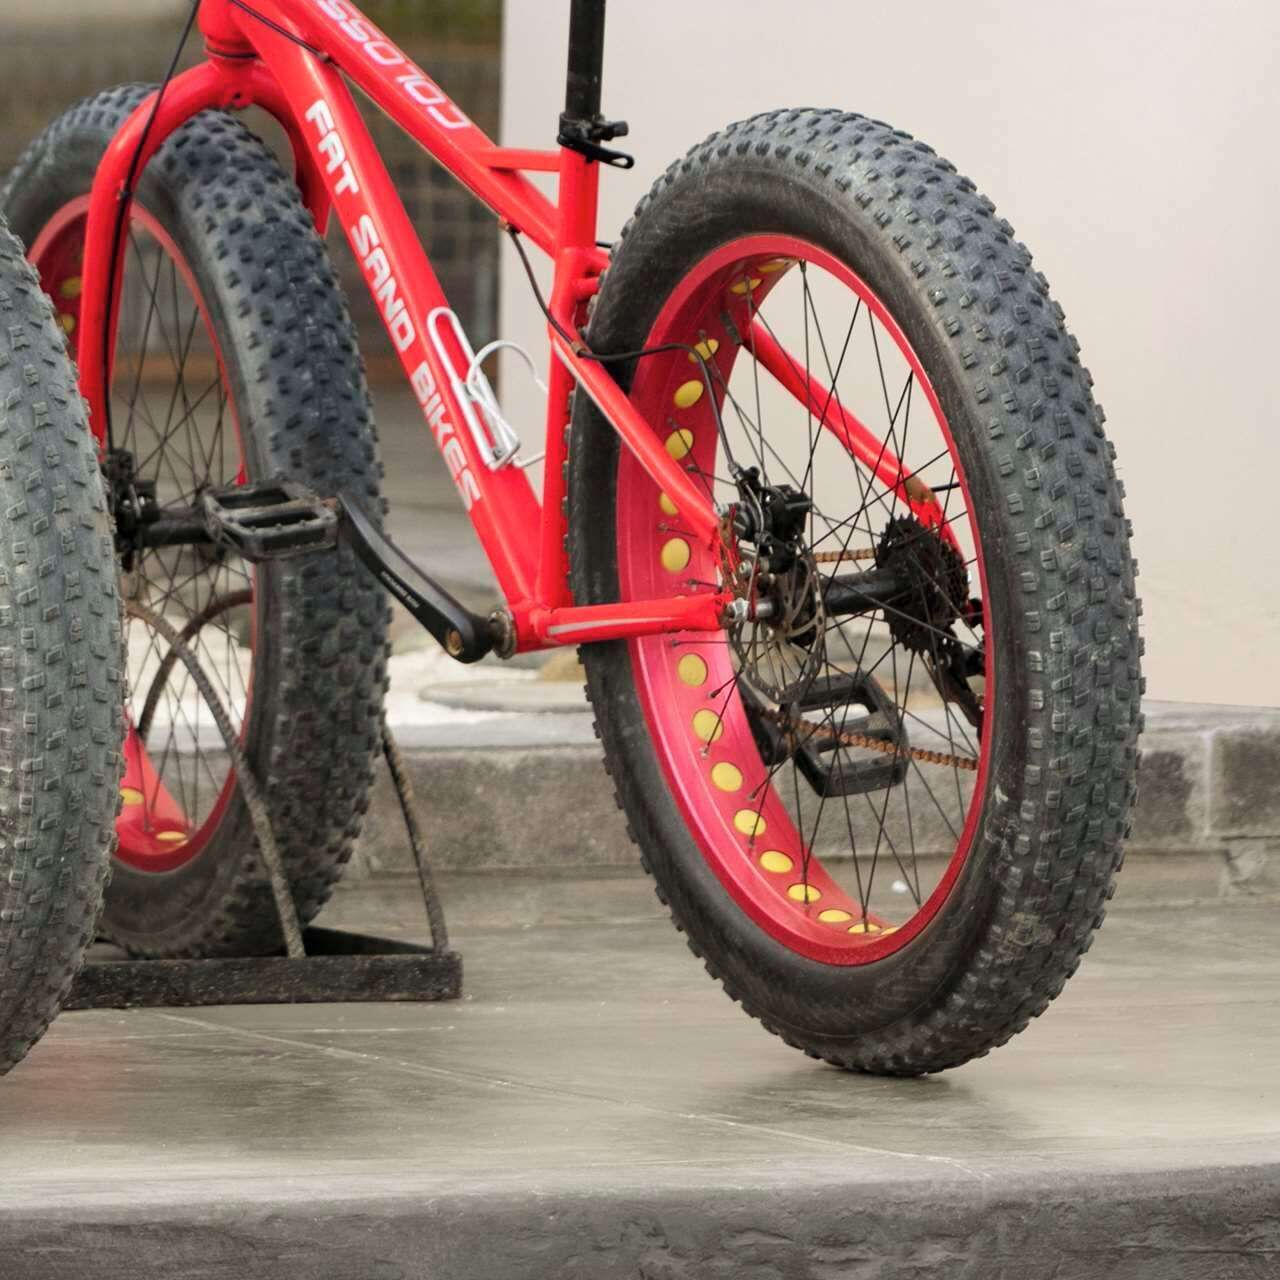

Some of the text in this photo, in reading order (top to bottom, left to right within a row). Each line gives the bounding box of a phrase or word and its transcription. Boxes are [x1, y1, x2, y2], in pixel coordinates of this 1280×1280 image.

[305, 99, 481, 512] FAT SAND BIKES
